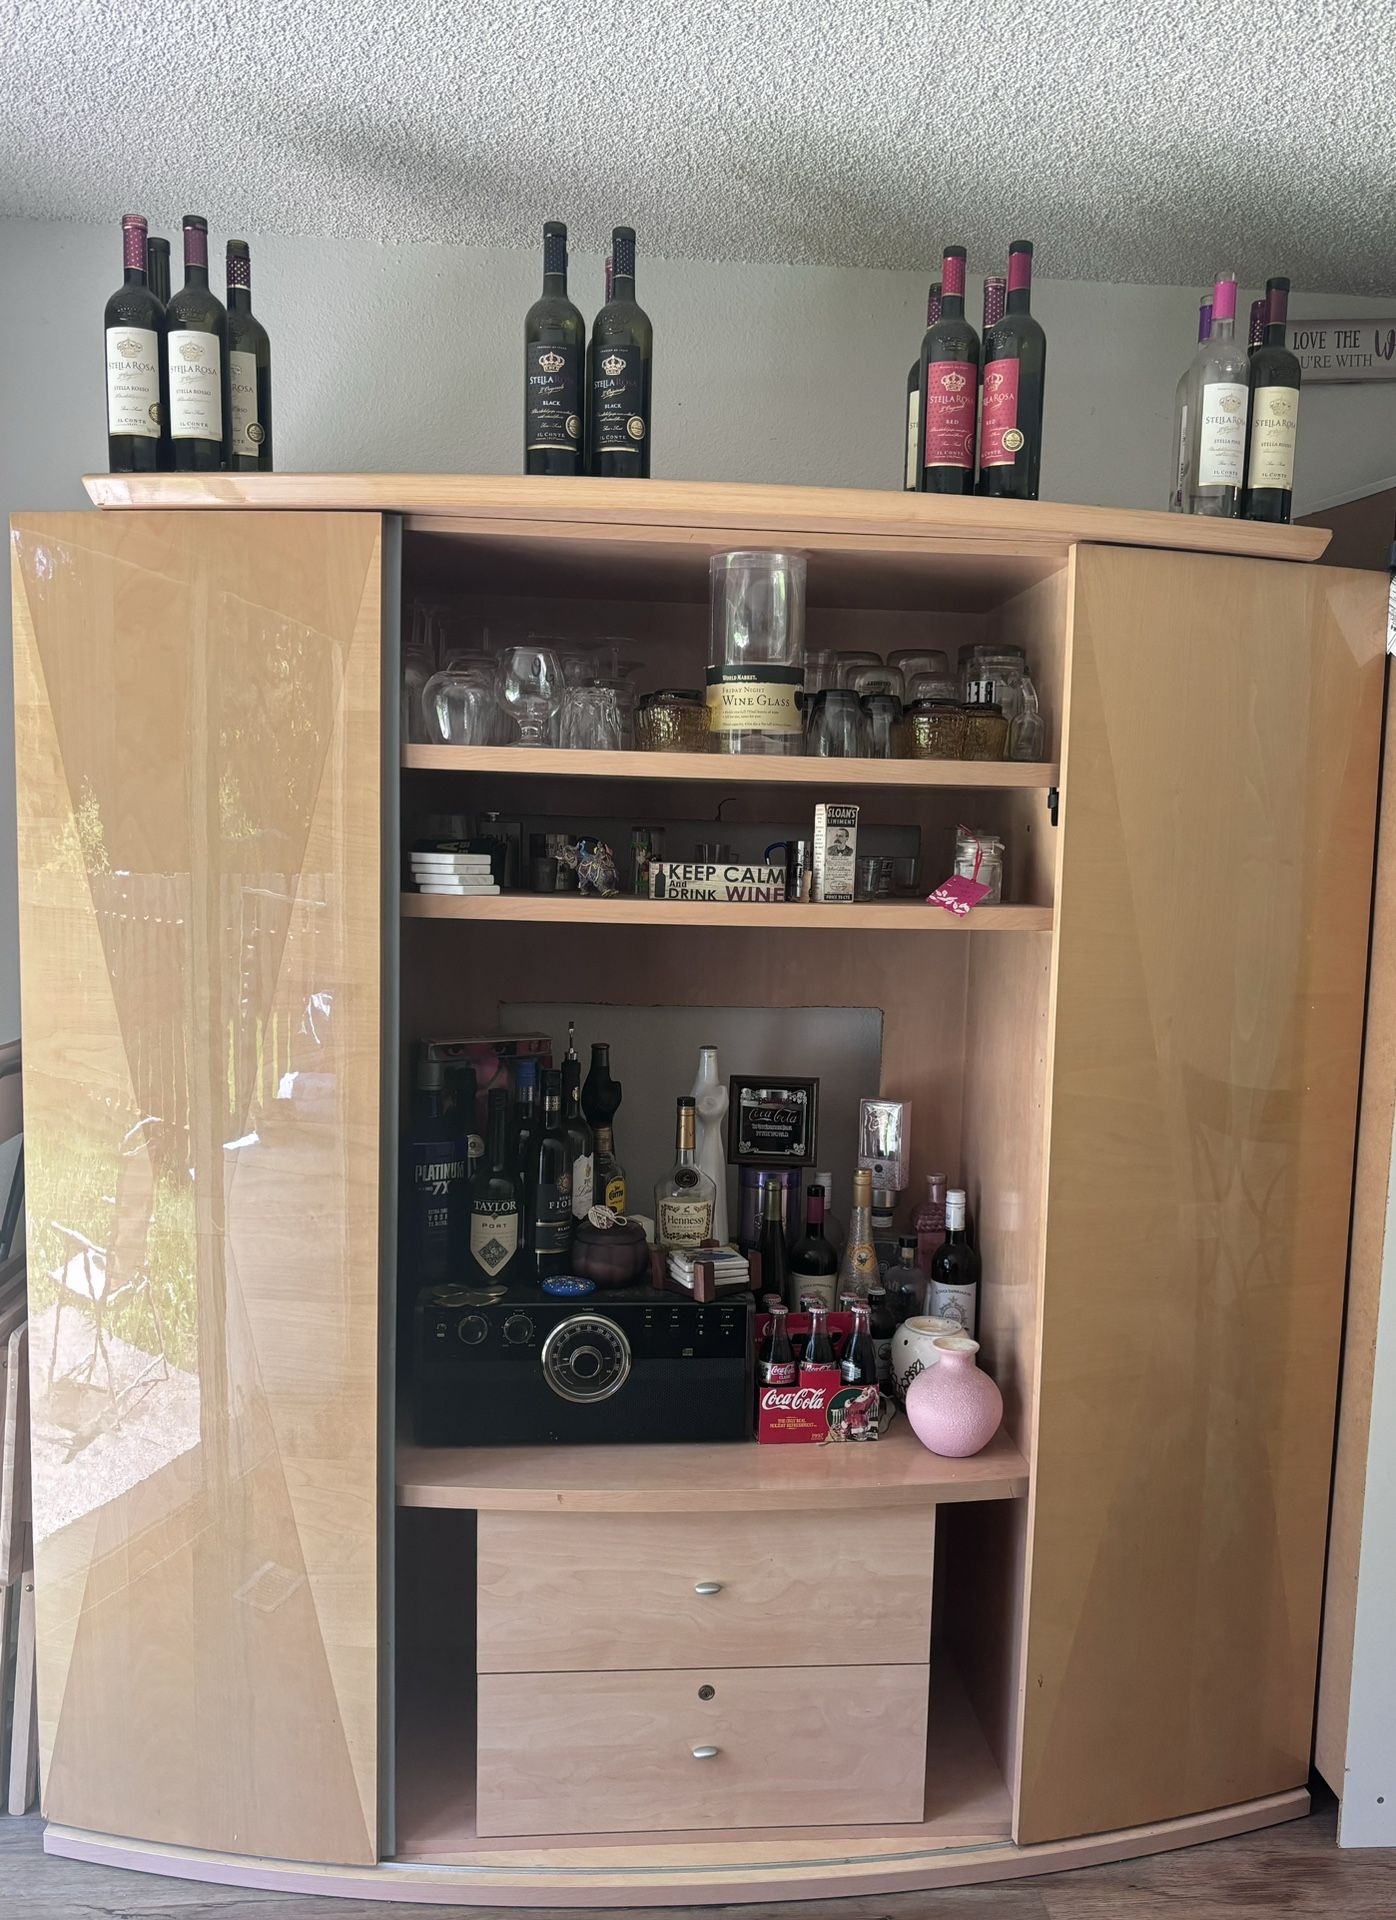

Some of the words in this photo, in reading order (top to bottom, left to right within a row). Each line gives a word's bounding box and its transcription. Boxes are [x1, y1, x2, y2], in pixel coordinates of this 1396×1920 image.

[1293, 331, 1327, 350] LOVE
[1334, 330, 1361, 349] THE
[1300, 355, 1331, 369] U'RE
[1336, 354, 1373, 368] WITH
[930, 394, 955, 405] STELLA
[669, 864, 717, 881] KEEP
[724, 866, 785, 884] CALM
[669, 880, 687, 888] And
[668, 888, 717, 901] DRINK
[725, 885, 785, 902] WINE
[414, 1161, 465, 1183] PLATINUM
[432, 1180, 451, 1196] 7X
[473, 1200, 517, 1212] TAYLOR
[667, 1215, 704, 1226] Hennessy
[761, 1387, 827, 1410] Coca-Cola
